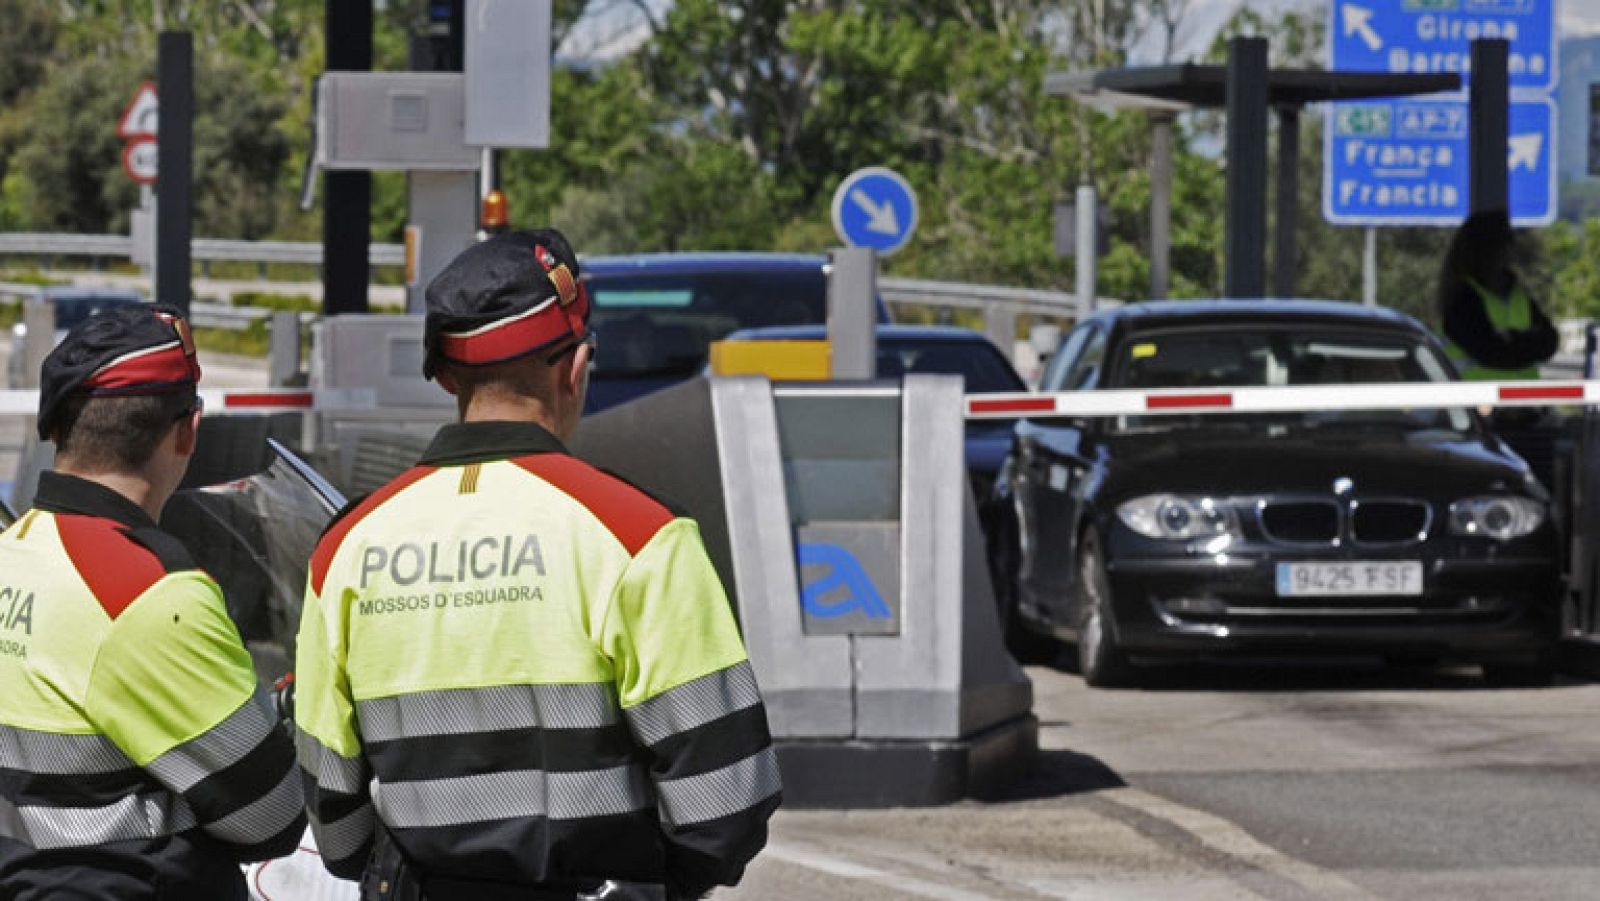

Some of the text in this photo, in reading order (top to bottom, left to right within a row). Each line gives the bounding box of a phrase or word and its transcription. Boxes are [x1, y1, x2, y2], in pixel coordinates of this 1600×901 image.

[1417, 15, 1518, 41] Girona
[1340, 181, 1459, 206] Francia
[360, 534, 547, 588] POLICIA
[360, 586, 543, 615] MOSSOS D'ESQUADRA
